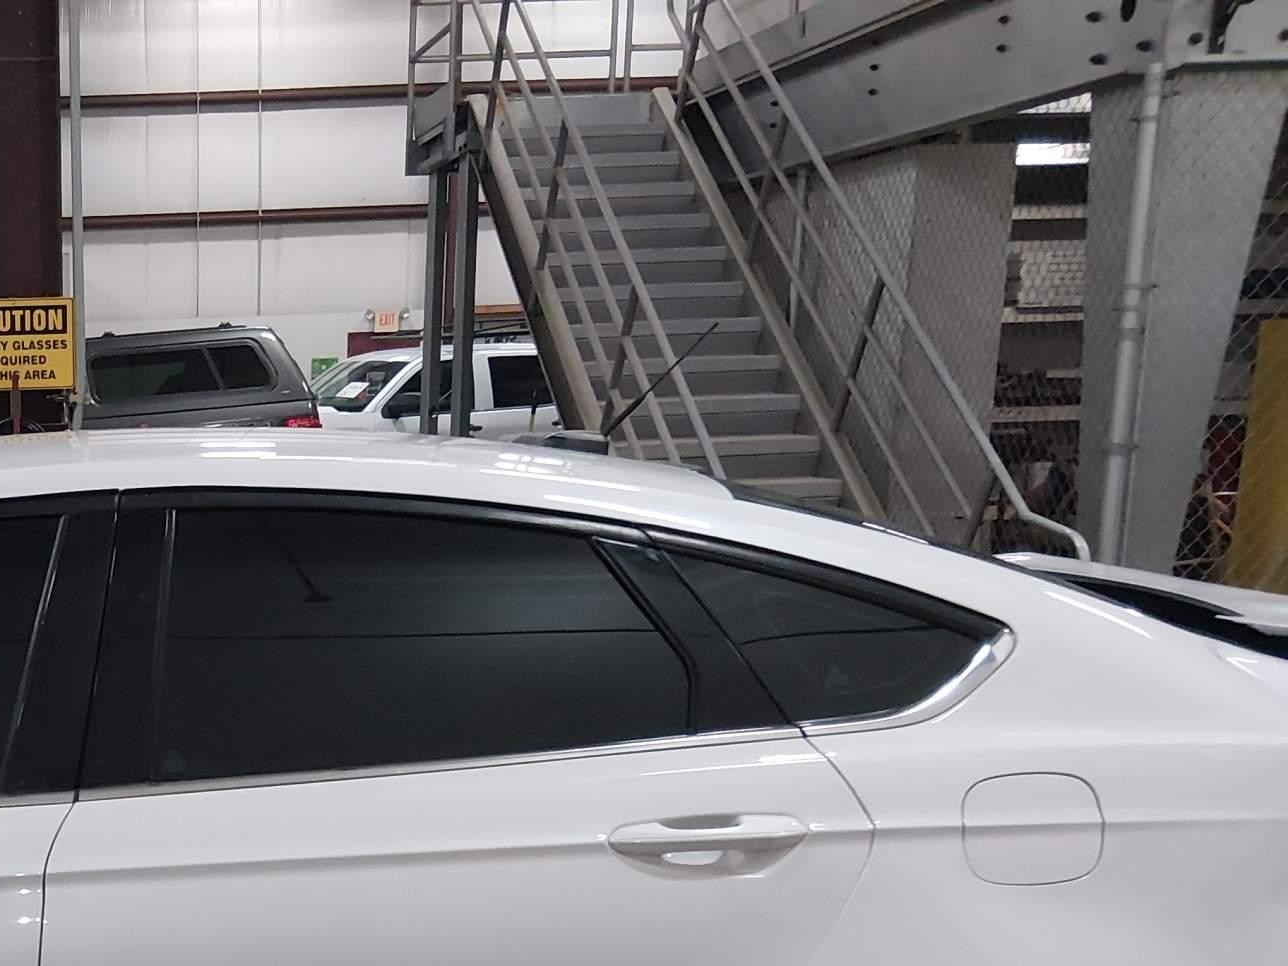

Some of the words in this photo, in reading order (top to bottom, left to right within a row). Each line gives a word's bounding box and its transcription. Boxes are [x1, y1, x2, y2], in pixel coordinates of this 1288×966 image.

[379, 312, 395, 327] EXIT
[12, 339, 68, 351] GLASSES
[24, 369, 57, 380] AREA
